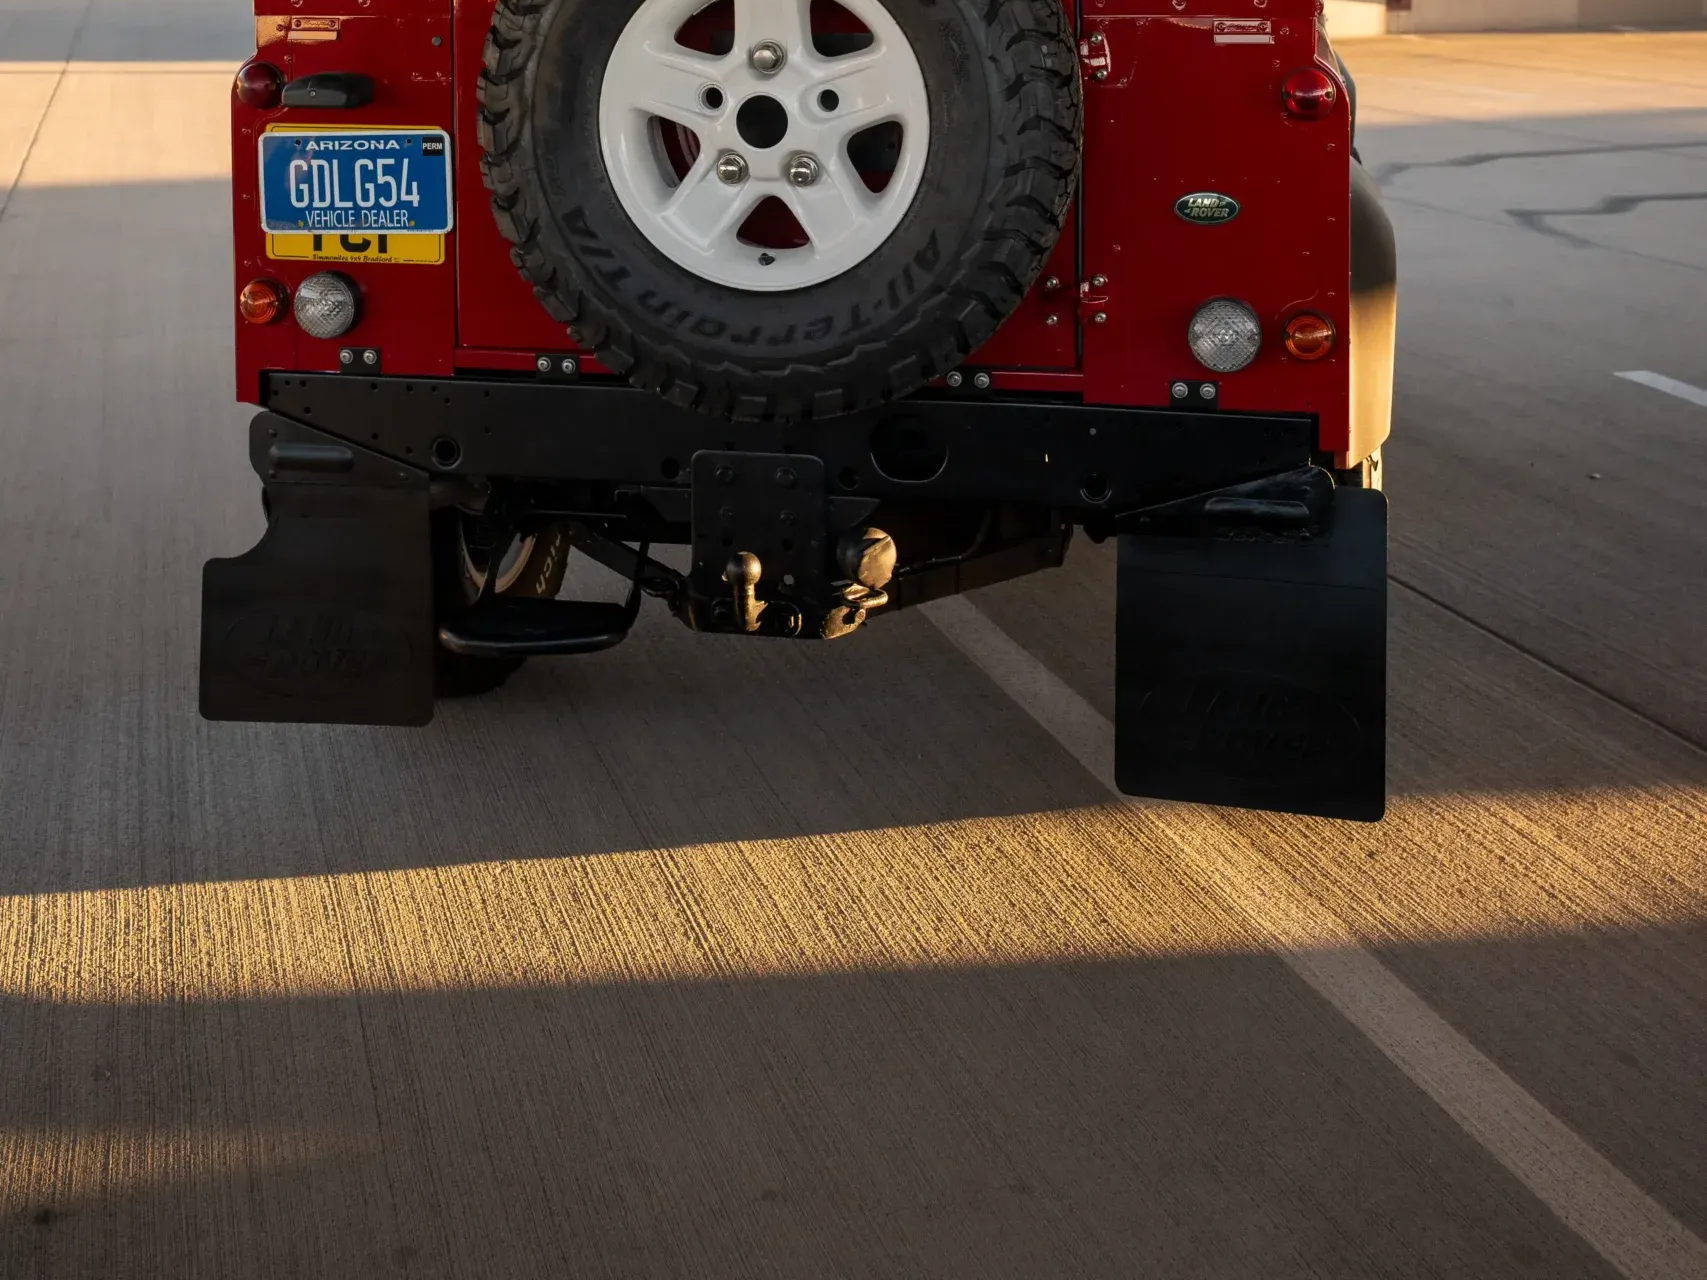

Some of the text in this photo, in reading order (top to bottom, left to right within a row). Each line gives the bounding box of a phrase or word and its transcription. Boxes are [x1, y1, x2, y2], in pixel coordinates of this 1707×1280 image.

[305, 139, 400, 151] ARIZONA
[422, 142, 443, 150] PERM
[289, 158, 420, 208] GDLG54
[1187, 197, 1219, 207] LAND
[1190, 207, 1229, 218] ROVER
[305, 210, 409, 227] VEHICLE DEALER
[362, 255, 392, 263] Bradford
